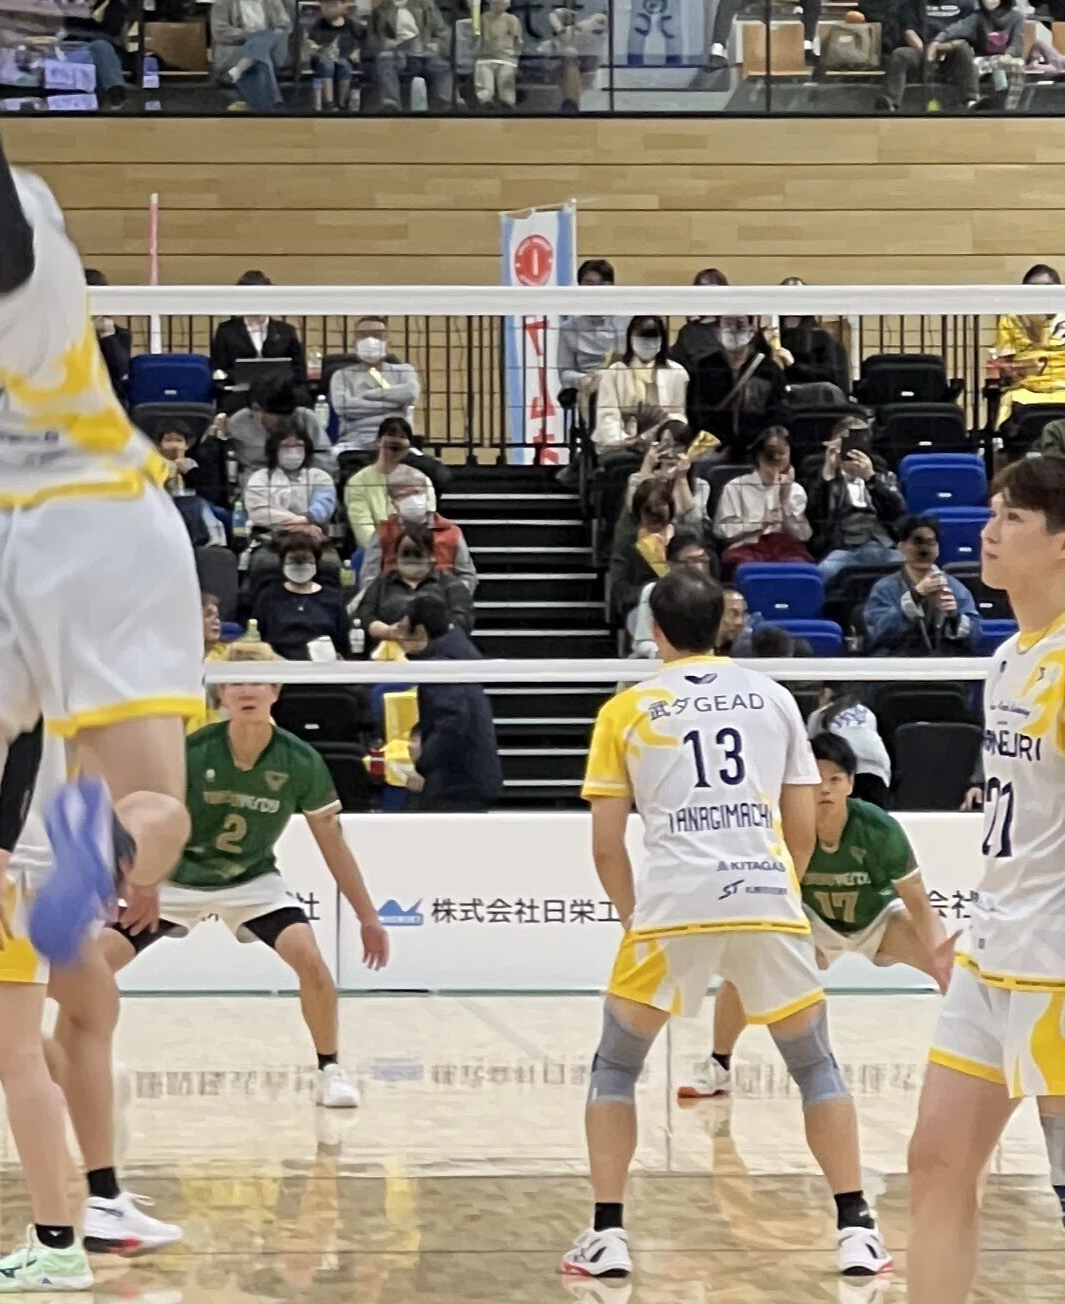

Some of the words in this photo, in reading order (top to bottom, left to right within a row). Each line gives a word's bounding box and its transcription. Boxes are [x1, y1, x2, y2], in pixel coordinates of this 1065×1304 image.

[683, 727, 746, 788] 13
[215, 813, 248, 854] 2
[813, 890, 860, 924] 17
